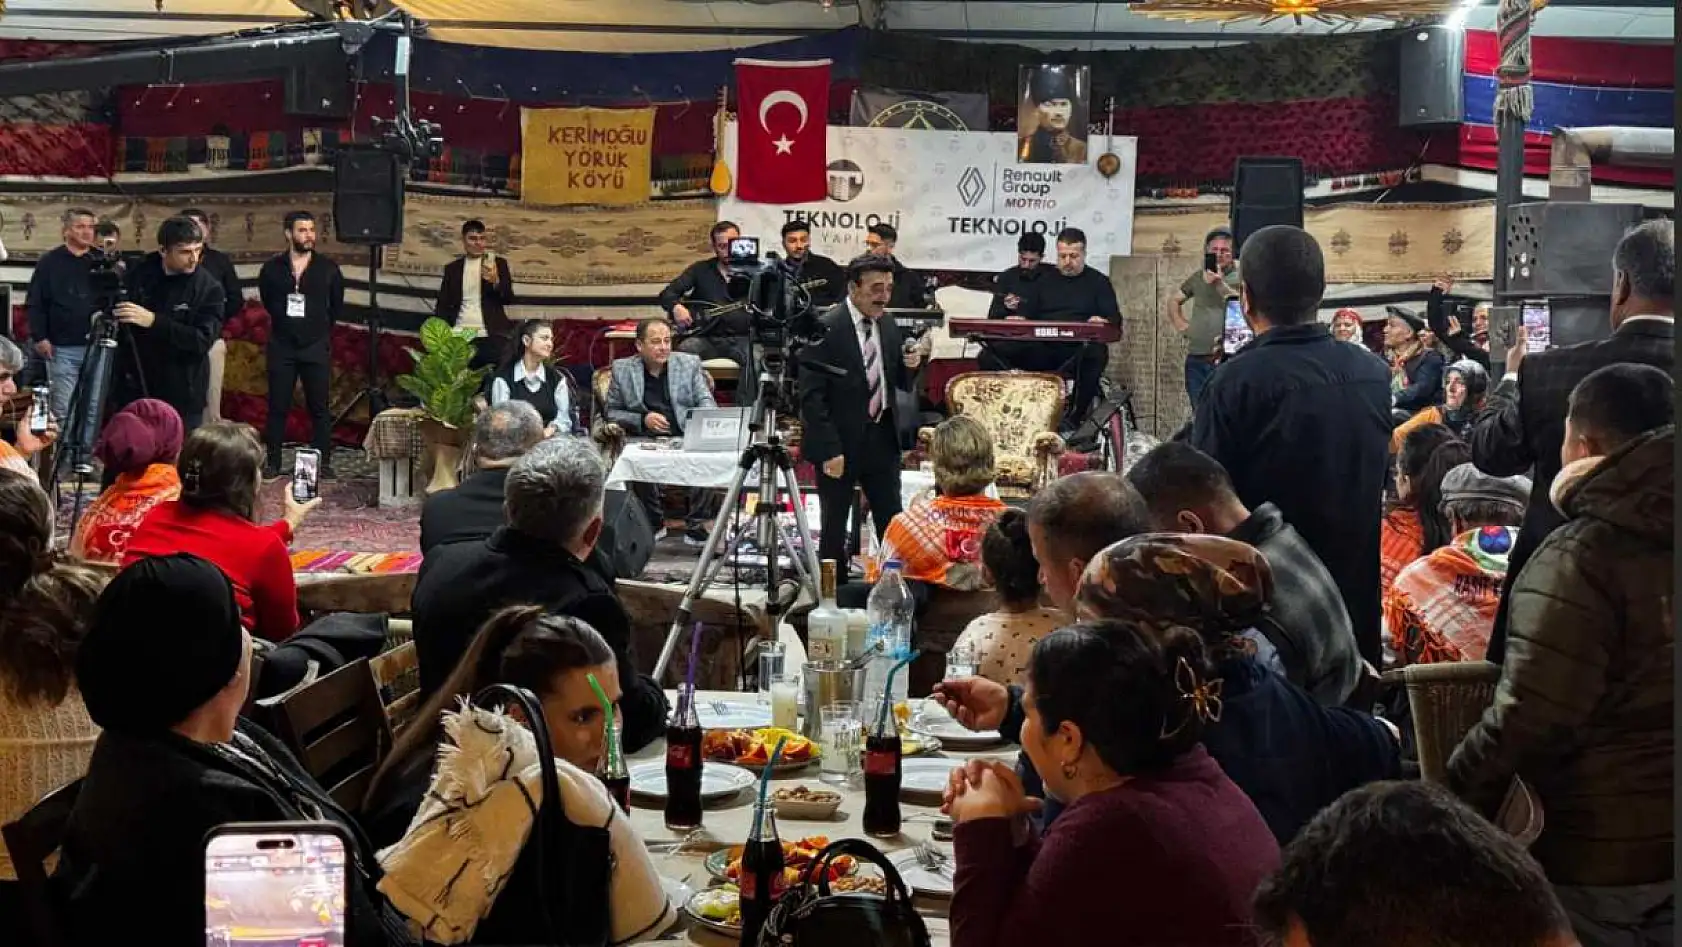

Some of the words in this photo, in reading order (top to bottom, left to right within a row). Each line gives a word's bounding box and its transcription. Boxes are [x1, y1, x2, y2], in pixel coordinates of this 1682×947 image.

[547, 122, 647, 145] KERİMOĞLU
[564, 145, 628, 168] YÖRÜK
[567, 169, 624, 189] KÖYÜ
[1003, 168, 1063, 183] Renault
[1002, 181, 1051, 196] Group
[1004, 198, 1056, 209] MOTRIO
